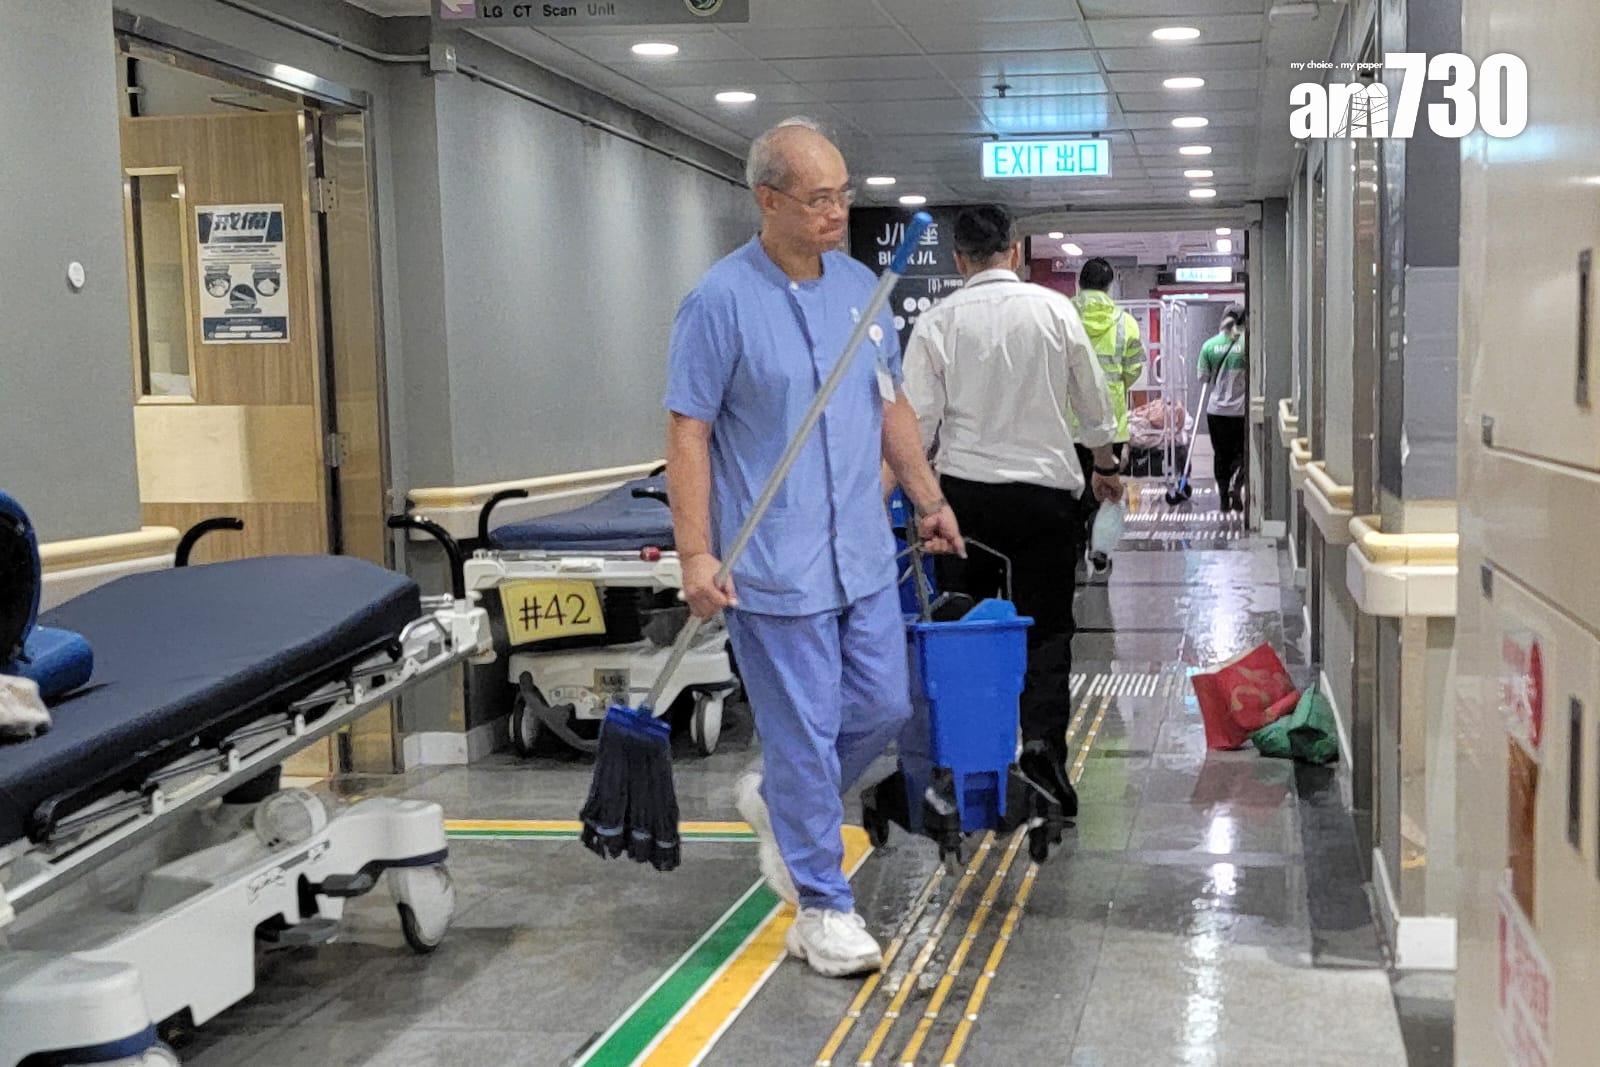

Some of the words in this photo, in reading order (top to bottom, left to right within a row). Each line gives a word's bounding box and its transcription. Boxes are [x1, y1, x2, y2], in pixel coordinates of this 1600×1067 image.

[483, 5, 503, 18] LG
[513, 5, 532, 18] CT
[543, 4, 577, 17] Scan
[587, 3, 615, 16] Unit
[994, 145, 1048, 175] EXIT
[1056, 144, 1097, 173] 出口
[878, 250, 915, 266] Blk
[916, 250, 937, 265] J/L
[519, 593, 591, 631] #42
